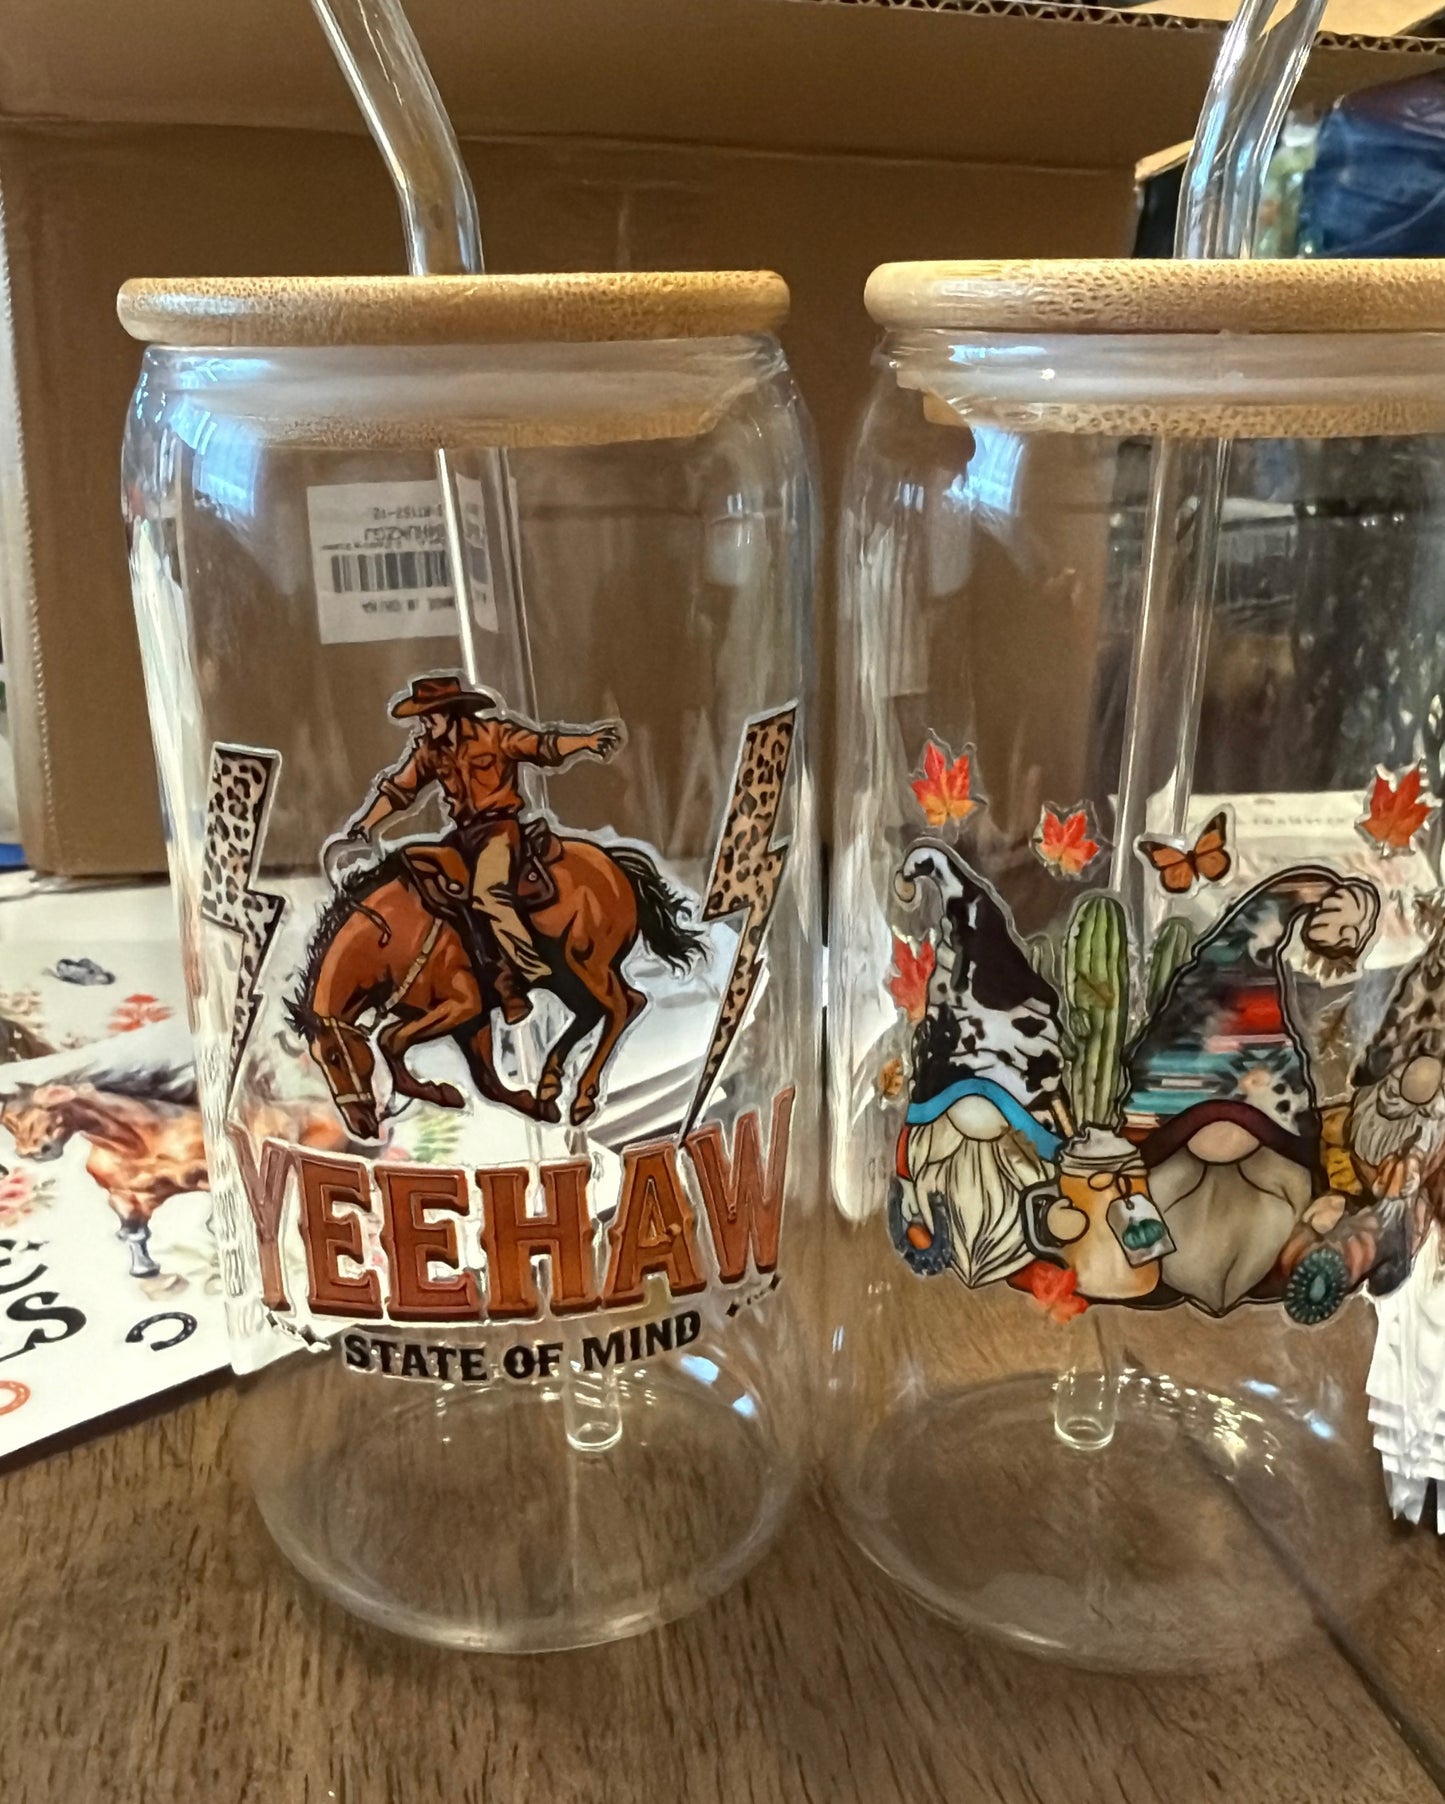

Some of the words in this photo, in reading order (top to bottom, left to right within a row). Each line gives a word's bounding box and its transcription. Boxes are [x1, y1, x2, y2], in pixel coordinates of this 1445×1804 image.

[228, 1086, 795, 1321] YEEHAW
[345, 1334, 488, 1382] STATE
[504, 1342, 563, 1379] OF
[582, 1310, 701, 1371] MIND
